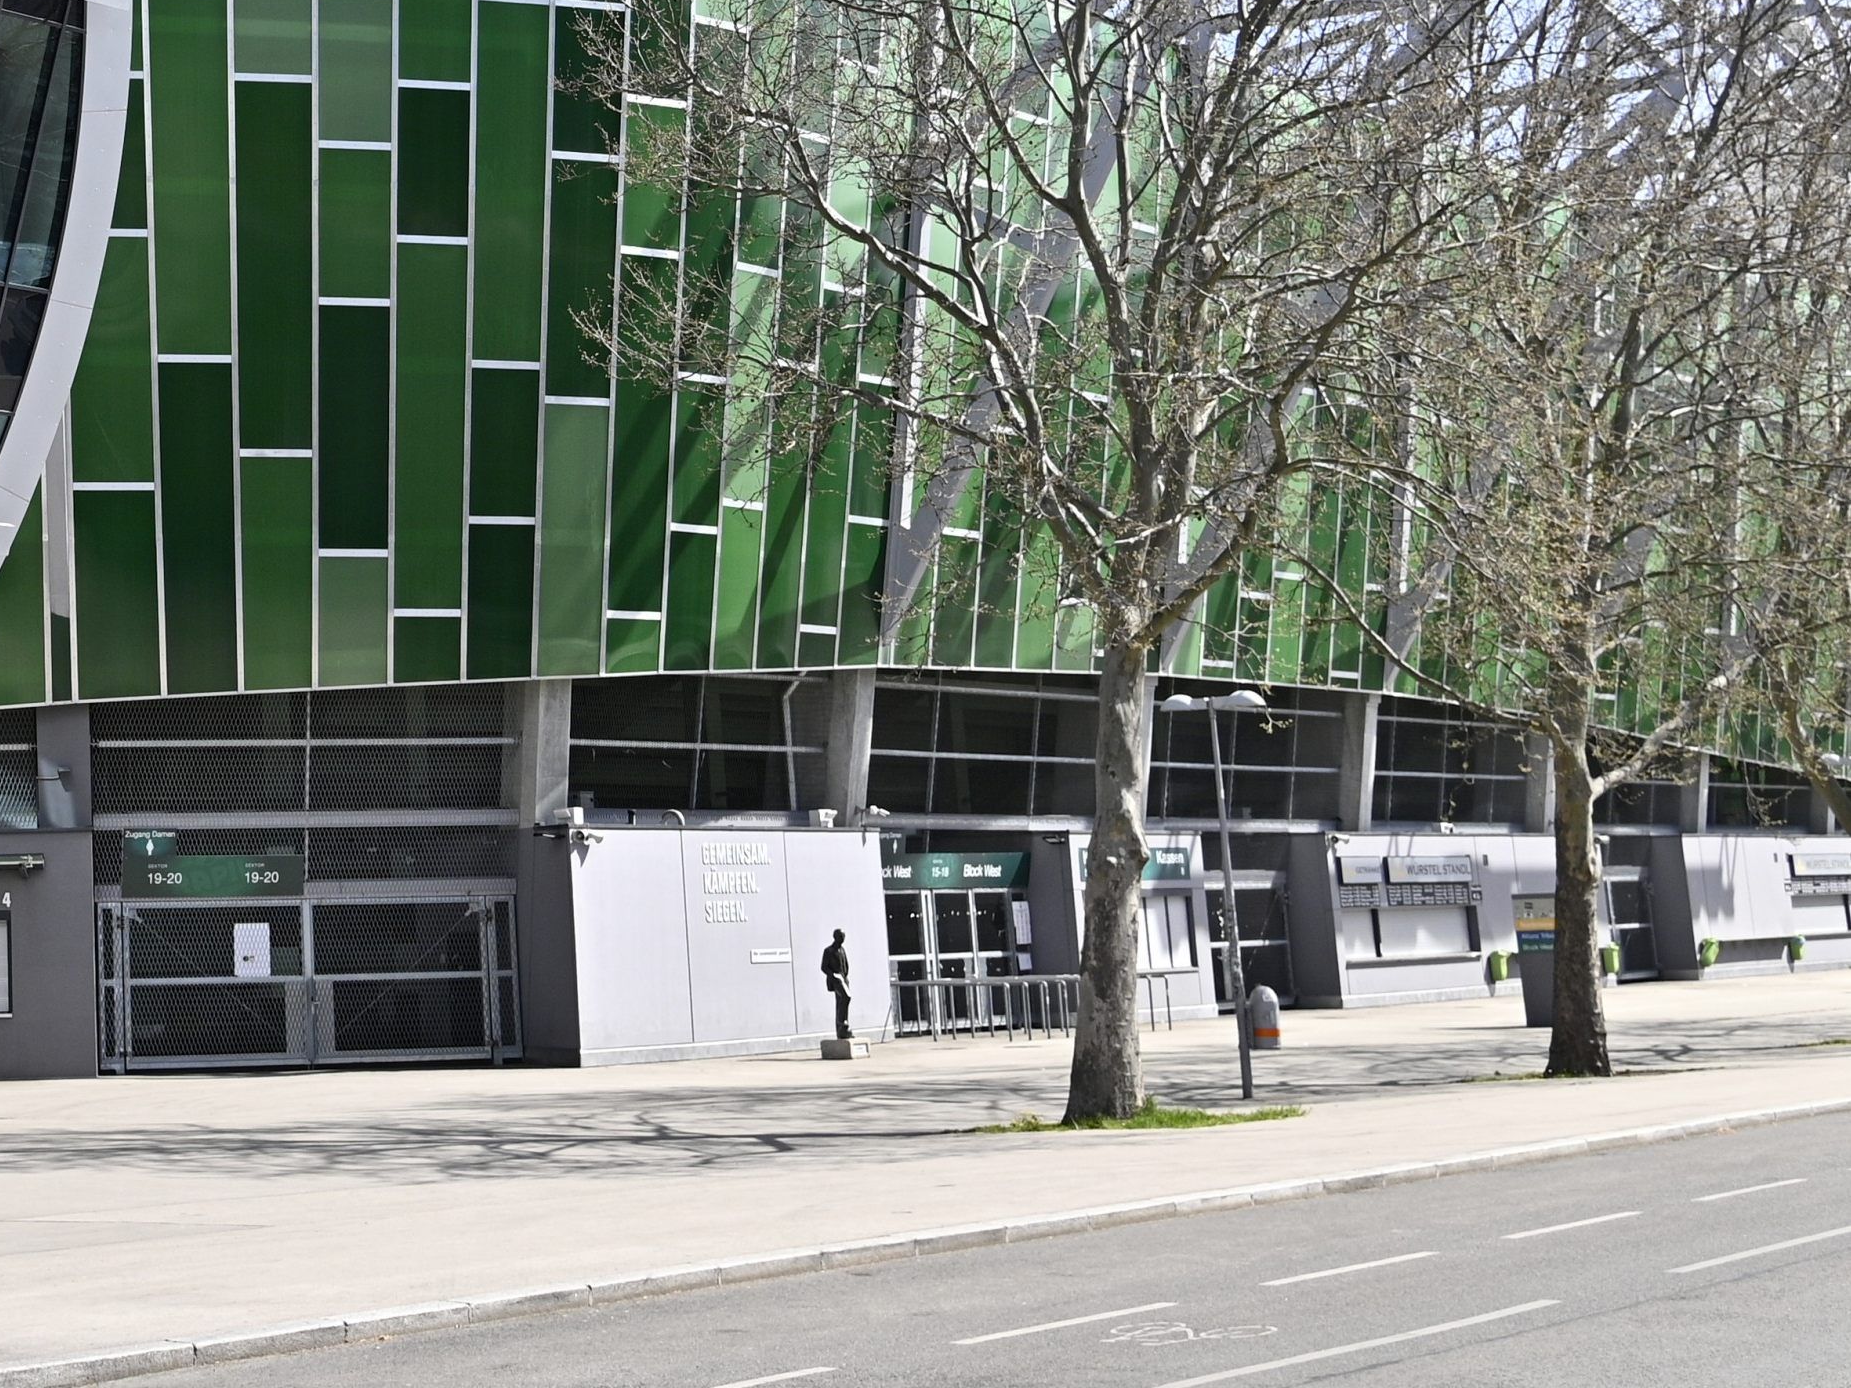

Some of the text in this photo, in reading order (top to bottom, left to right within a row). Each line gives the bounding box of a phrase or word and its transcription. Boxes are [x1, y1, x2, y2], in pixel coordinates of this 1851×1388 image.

[124, 830, 176, 839] Zugang Damen
[701, 842, 772, 866] GEMEINSAM.
[244, 871, 280, 884] 19-20
[893, 865, 912, 879] West
[962, 863, 1002, 878] Block West
[147, 872, 183, 885] 19-20
[702, 867, 760, 895] KÄMPFEN.
[2, 892, 11, 908] 4
[704, 899, 749, 924] SIEGEN.
